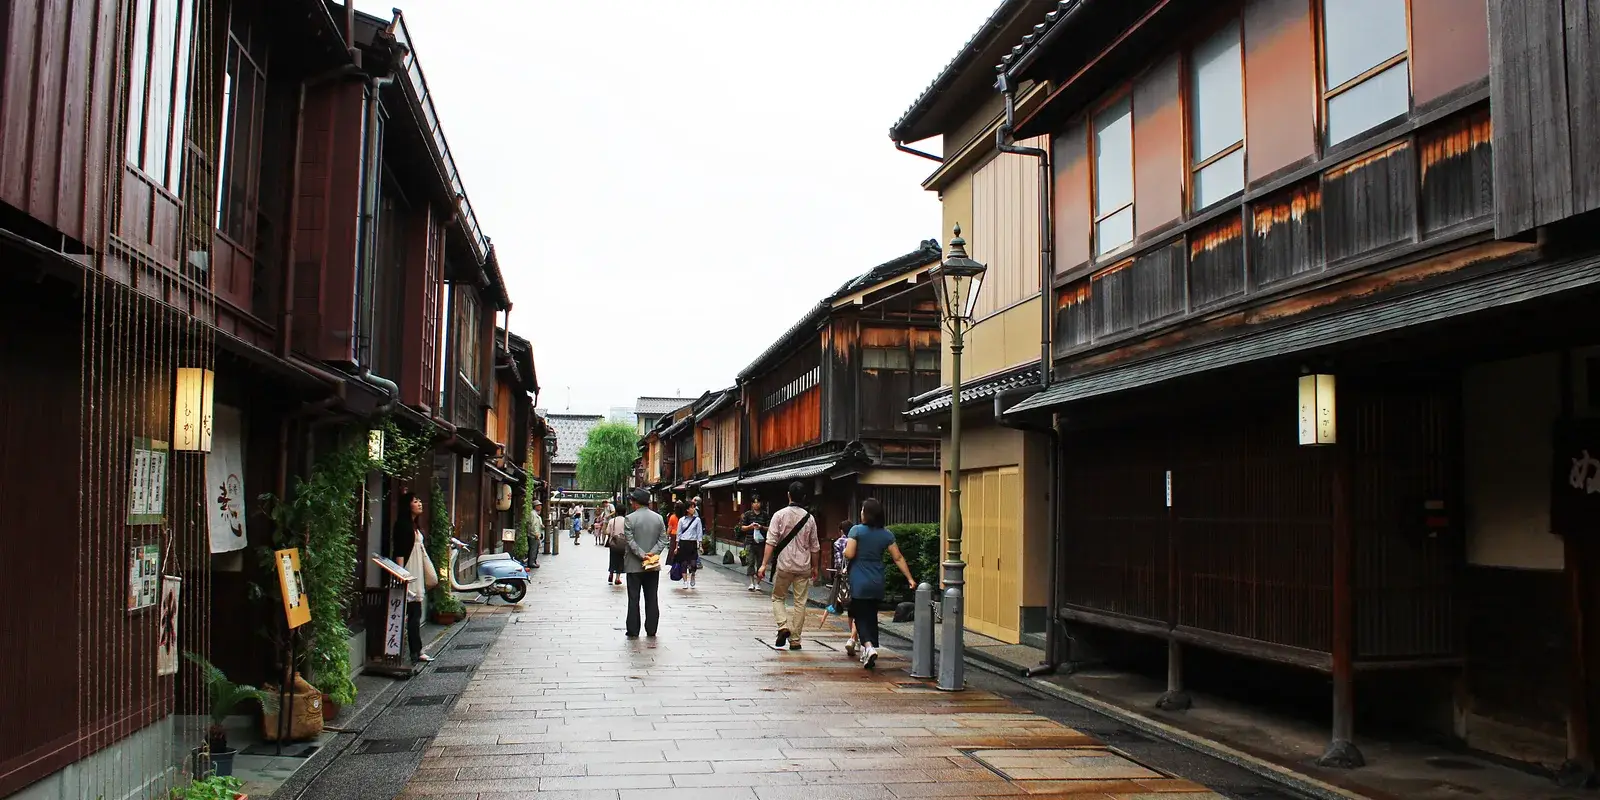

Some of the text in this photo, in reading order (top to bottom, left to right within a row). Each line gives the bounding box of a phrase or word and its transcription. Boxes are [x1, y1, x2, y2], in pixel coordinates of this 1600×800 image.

[183, 402, 193, 446] ひがし
[1322, 408, 1330, 438] ひがし
[387, 599, 401, 649] ゆかた展
